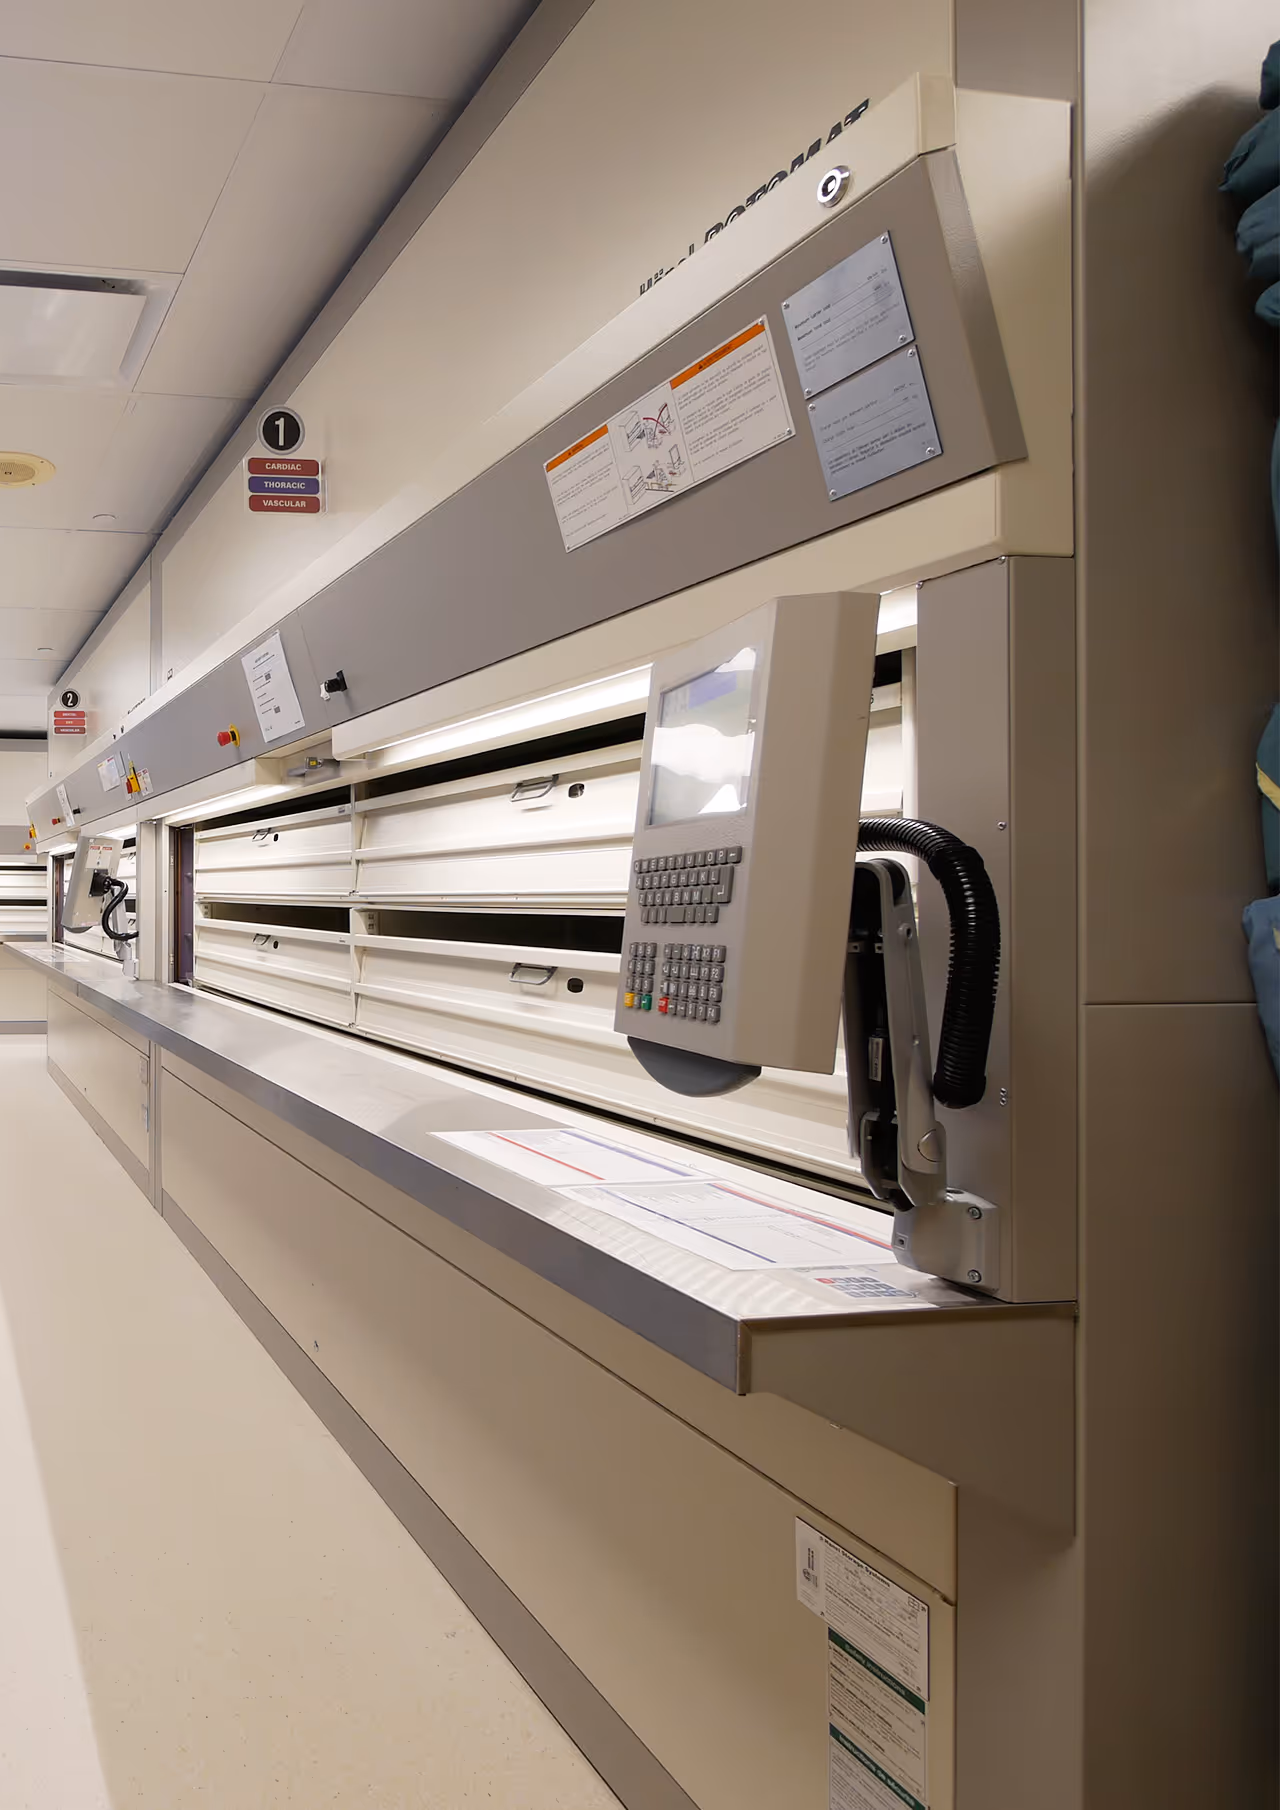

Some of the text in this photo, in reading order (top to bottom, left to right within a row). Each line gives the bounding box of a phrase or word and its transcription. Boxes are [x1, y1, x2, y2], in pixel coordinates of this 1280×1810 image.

[275, 417, 286, 447] 1
[265, 463, 302, 471] CARDIAC
[263, 481, 306, 489] THORACIC
[262, 499, 306, 508] VASCULAR
[67, 693, 73, 706] 2
